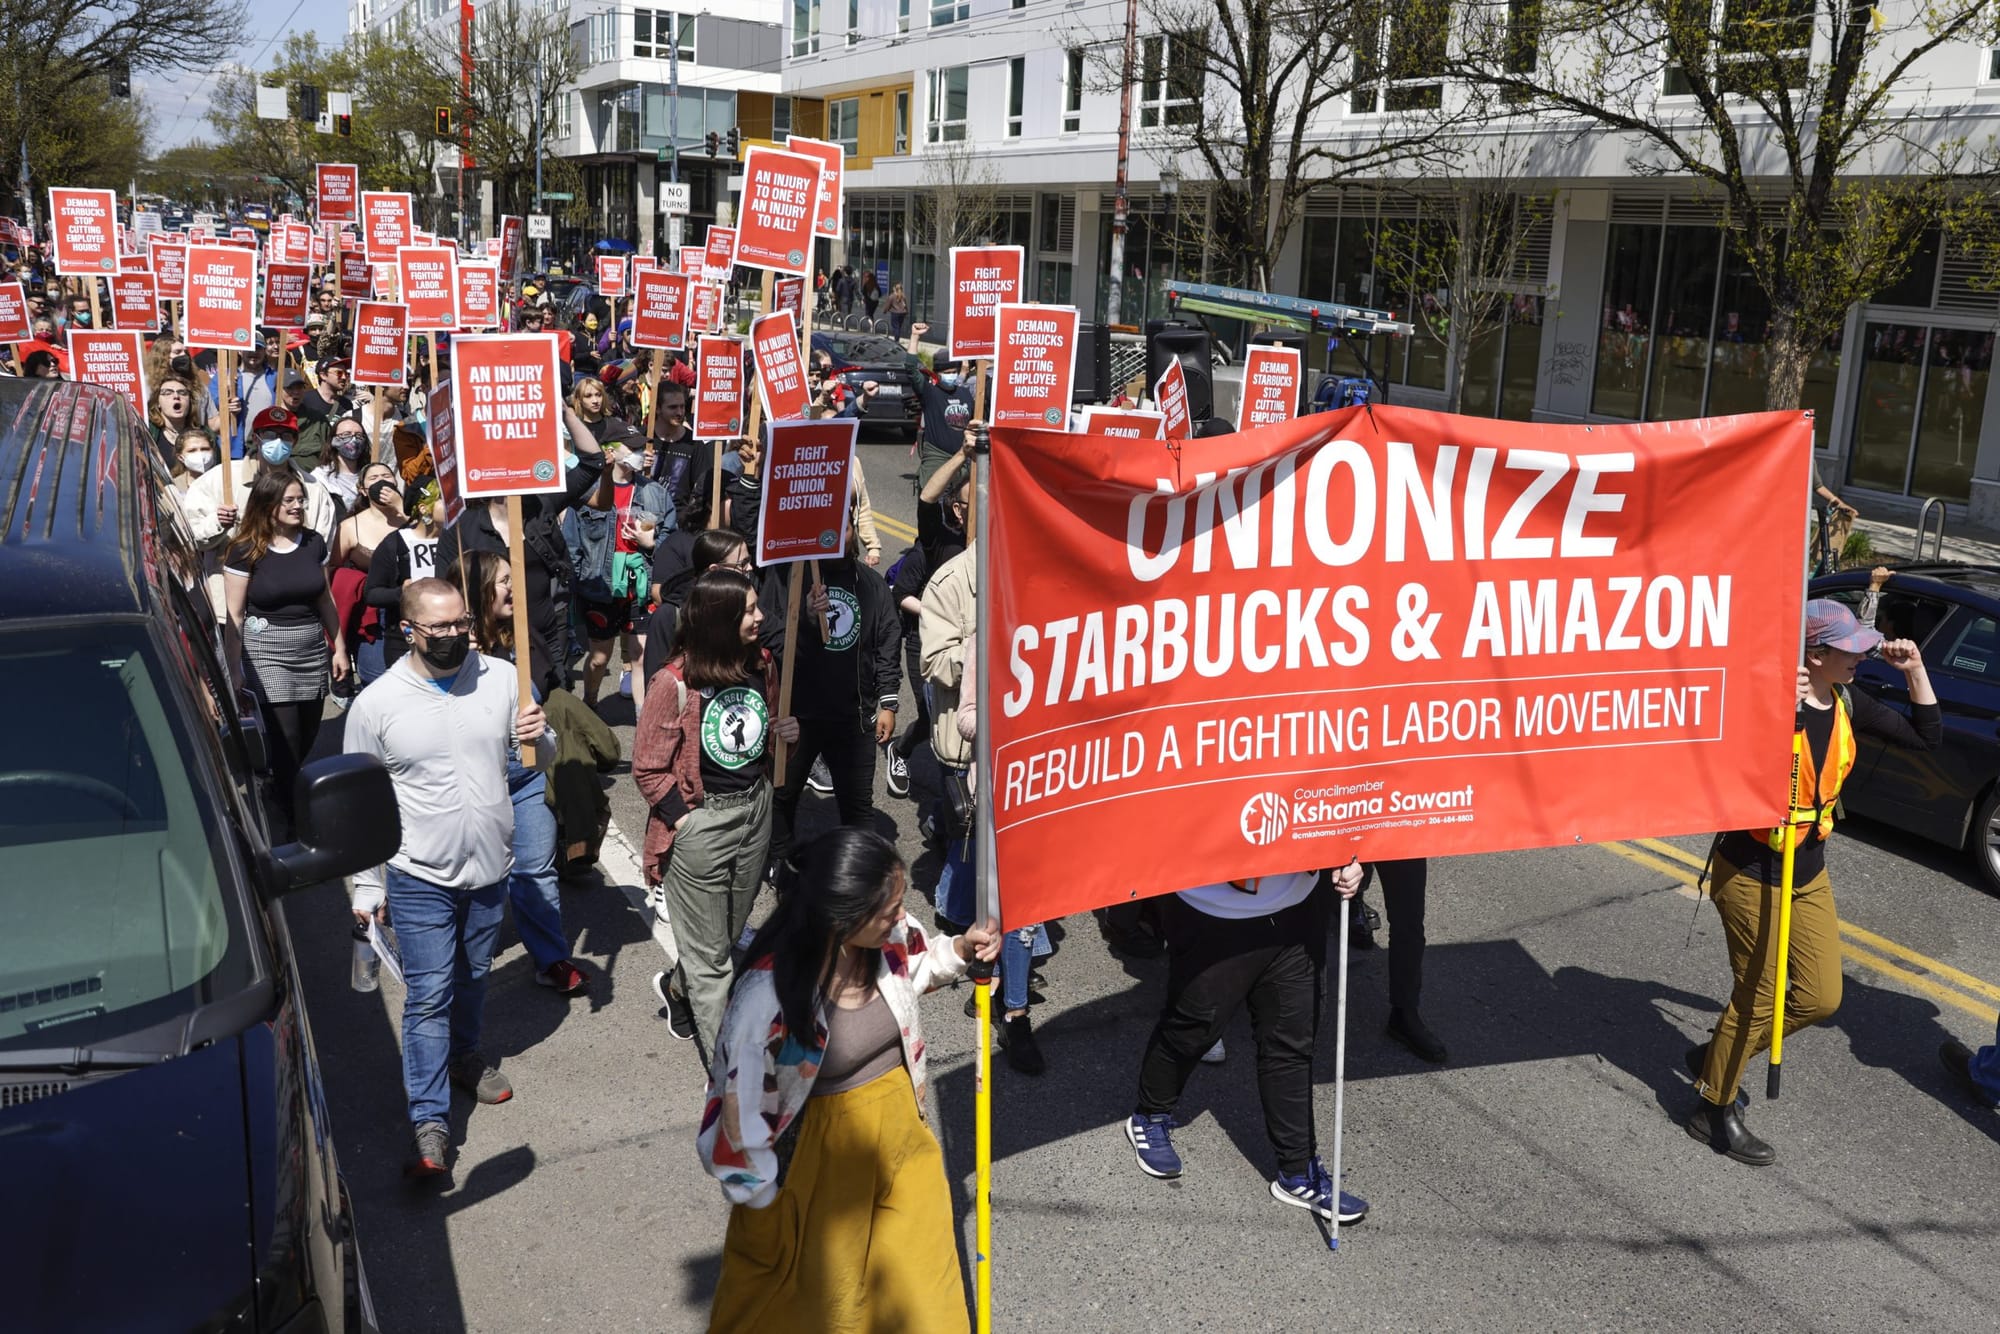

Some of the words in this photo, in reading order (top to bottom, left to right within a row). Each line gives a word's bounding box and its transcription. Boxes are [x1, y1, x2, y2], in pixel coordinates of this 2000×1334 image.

[755, 170, 770, 184] AN
[774, 174, 810, 191] INJURY
[668, 188, 682, 197] NO
[756, 185, 769, 198] TO
[772, 188, 793, 202] ONE
[796, 192, 806, 205] IS
[66, 199, 98, 207] DEMAND
[662, 200, 688, 209] TURNS
[61, 208, 105, 216] STARBUCKS
[751, 199, 766, 212] AN
[770, 202, 806, 219] INJURY
[758, 214, 770, 227] TO
[773, 216, 796, 232] ALL!
[68, 226, 100, 234] CUTTING
[66, 234, 106, 243] EMPLOYEE
[73, 244, 100, 252] HOURS!
[208, 264, 234, 275] FIGHT
[408, 263, 437, 271] REBUILD
[411, 272, 443, 280] FIGHTING
[975, 268, 1001, 279] FIGHT
[193, 275, 249, 288] STARBUCKS'
[960, 280, 1015, 292] STARBUCKS'
[206, 286, 234, 298] UNION
[408, 290, 448, 298] MOVEMENT
[646, 284, 673, 294] REBUILD
[199, 298, 242, 310] BUSTING!
[647, 294, 677, 303] FIGHTING
[973, 293, 1001, 304] UNION
[651, 303, 672, 311] LABOR
[642, 310, 680, 320] MOVEMENT
[373, 317, 394, 326] FIGHT
[1017, 320, 1057, 332] DEMAND
[361, 326, 403, 336] STARBUCKS'
[371, 337, 393, 345] UNION
[759, 340, 768, 354] AN
[769, 333, 791, 350] INJURY
[1009, 334, 1063, 347] STARBUCKS
[365, 345, 398, 355] BUSTING!
[1022, 348, 1046, 358] STOP
[83, 353, 129, 362] STARBUCKS
[706, 356, 732, 367] REBUILD
[732, 357, 737, 366] A
[763, 354, 773, 367] TO
[774, 351, 786, 364] ONE
[787, 348, 794, 360] IS
[88, 363, 128, 372] REINSTATE
[767, 368, 778, 382] AN
[778, 361, 797, 377] INJURY
[1014, 360, 1053, 372] CUTTING
[1260, 362, 1289, 373] DEMAND
[82, 374, 97, 382] ALL
[98, 373, 135, 382] WORKERS
[469, 367, 490, 383] AN
[494, 365, 544, 382] INJURY
[708, 368, 736, 378] FIGHTING
[712, 380, 732, 390] LABOR
[774, 381, 784, 394] TO
[785, 375, 798, 390] ALL!
[1009, 374, 1056, 385] EMPLOYEE
[1252, 374, 1292, 386] STARBUCKS
[115, 384, 129, 392] FOR
[473, 386, 492, 402] TO
[496, 385, 524, 401] ONE
[529, 385, 542, 400] IS
[1014, 387, 1048, 397] HOURS!
[1263, 387, 1281, 398] STOP
[703, 392, 737, 402] MOVEMENT
[1255, 400, 1284, 411] CUTTING
[472, 405, 492, 421] AN
[497, 403, 546, 420] INJURY
[483, 423, 502, 440] TO
[506, 422, 537, 439] ALL!
[1104, 427, 1139, 438] DEMAND
[794, 446, 828, 462] FIGHT
[774, 460, 845, 479] STARBUCKS'
[789, 478, 825, 494] UNION
[779, 494, 832, 511] BUSTING!
[1127, 440, 1635, 582] UNIONIZE
[1003, 585, 1370, 718] STARBUCKS
[1390, 582, 1443, 662] &
[1461, 574, 1732, 658] AMAZON
[711, 692, 762, 718] STARBUCKS
[706, 733, 738, 762] WORKERS
[1004, 731, 1145, 811] REBUILD
[1156, 725, 1182, 772] A
[1196, 706, 1369, 767] FIGHTING
[1382, 698, 1501, 747] LABOR
[1514, 686, 1710, 737] MOVEMENT
[1294, 780, 1384, 800] Councilmember
[1292, 797, 1383, 824] Kshama
[1389, 784, 1474, 812] Sawant
